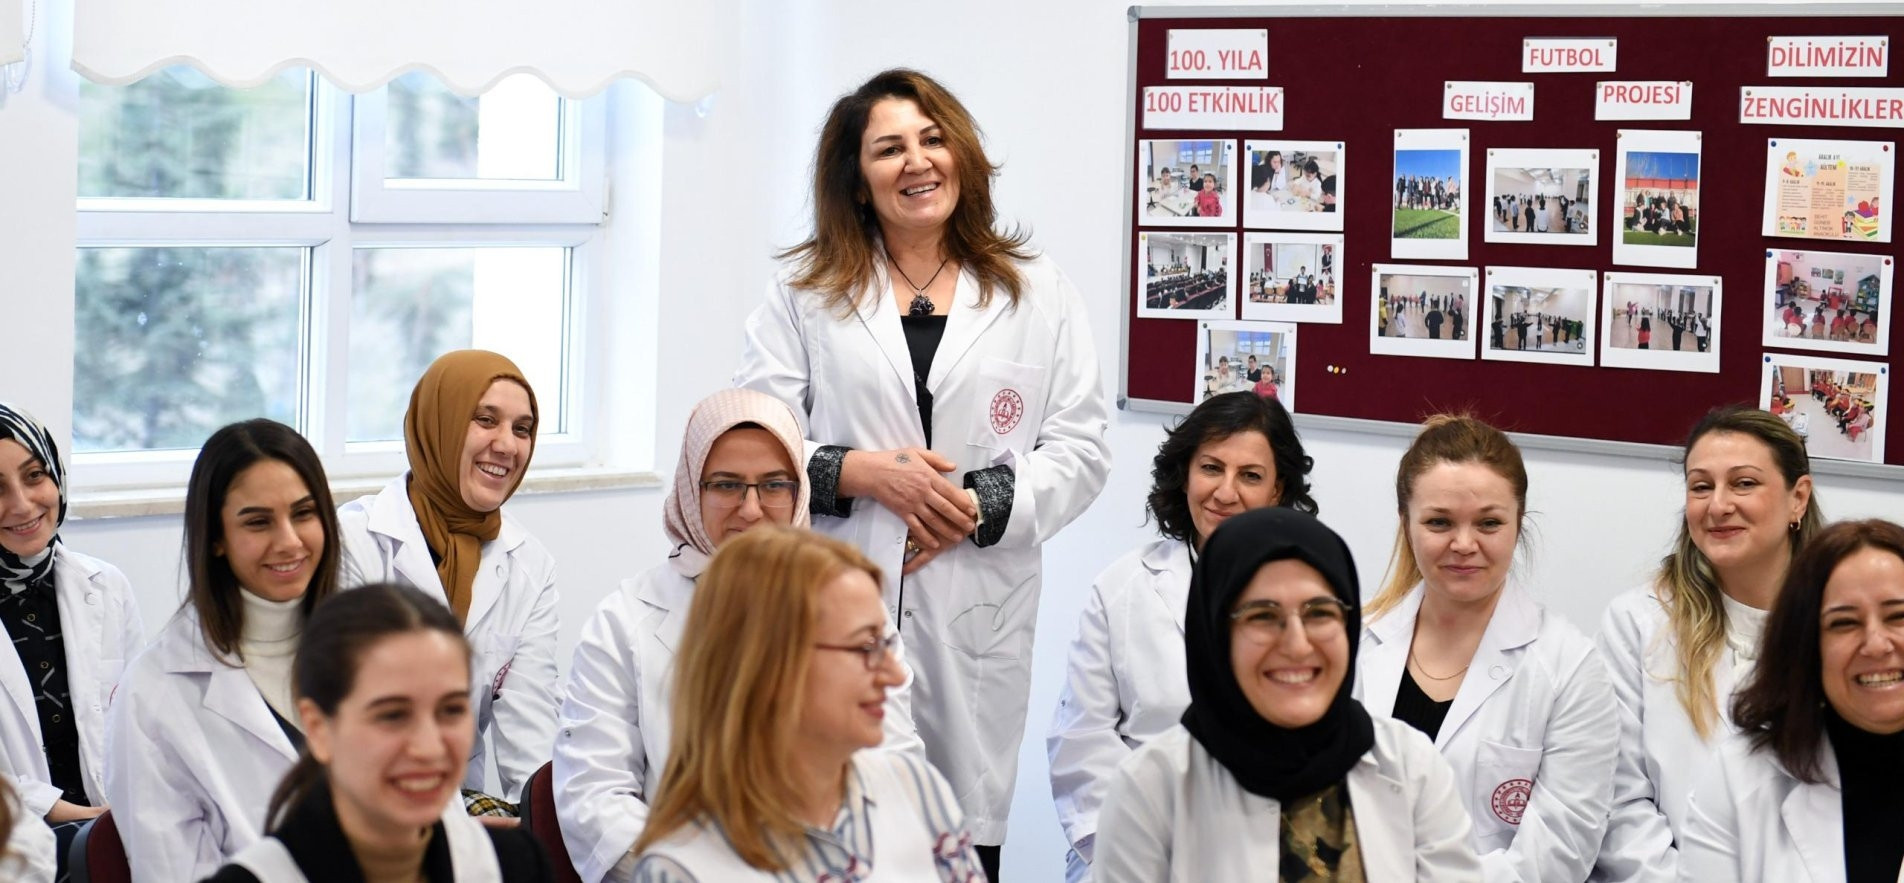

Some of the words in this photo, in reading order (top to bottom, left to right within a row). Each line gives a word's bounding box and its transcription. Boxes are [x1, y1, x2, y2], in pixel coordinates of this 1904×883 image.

[1169, 50, 1212, 72] 100.
[1218, 49, 1263, 71] YILA
[1529, 47, 1603, 67] FUTBOL
[1771, 41, 1884, 68] DİLİMİZİN
[1146, 92, 1182, 113] 100
[1187, 86, 1279, 114] ETKİNLİK
[1449, 91, 1525, 118] GELİŞİM
[1603, 81, 1681, 105] PROJESİ
[1743, 92, 1904, 121] ZENGİNLİKLER
